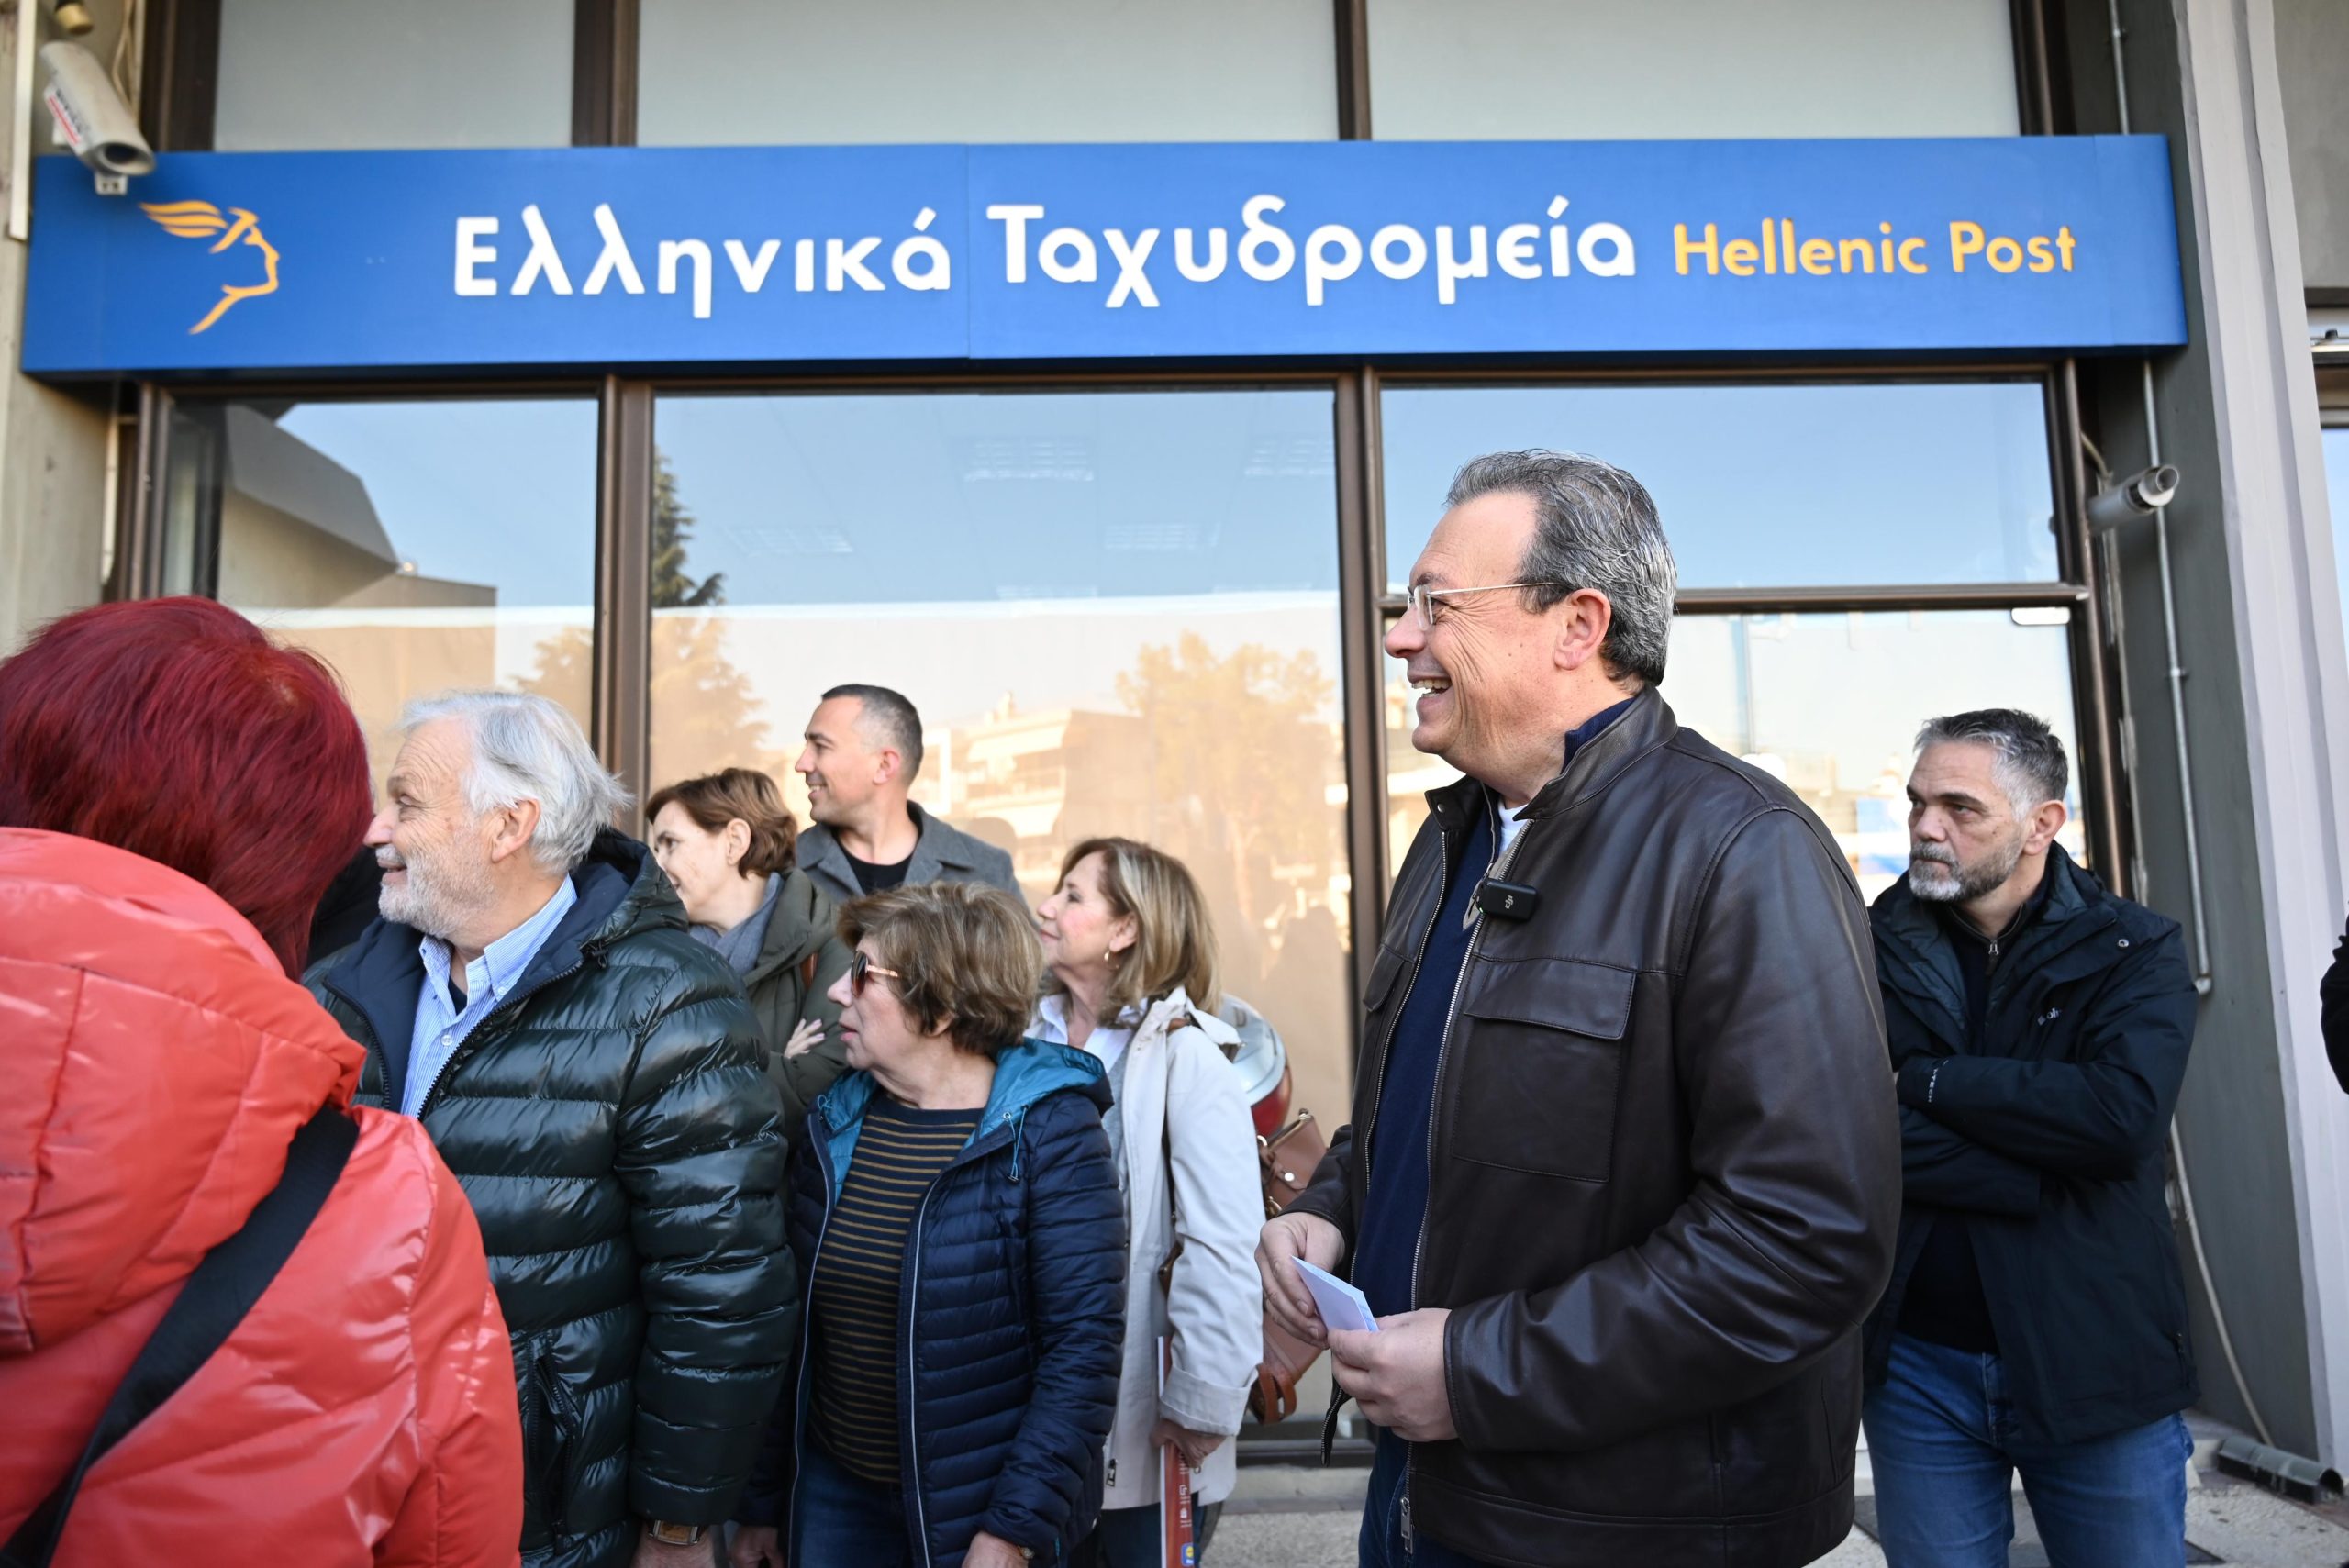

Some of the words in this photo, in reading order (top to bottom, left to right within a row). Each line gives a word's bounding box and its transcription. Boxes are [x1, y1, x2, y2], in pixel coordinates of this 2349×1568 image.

[454, 203, 952, 320] Ελληνικά
[985, 193, 1637, 309] Ταχυδρομεία
[1675, 218, 1928, 274] Hellenic
[1951, 221, 2076, 272] Post
